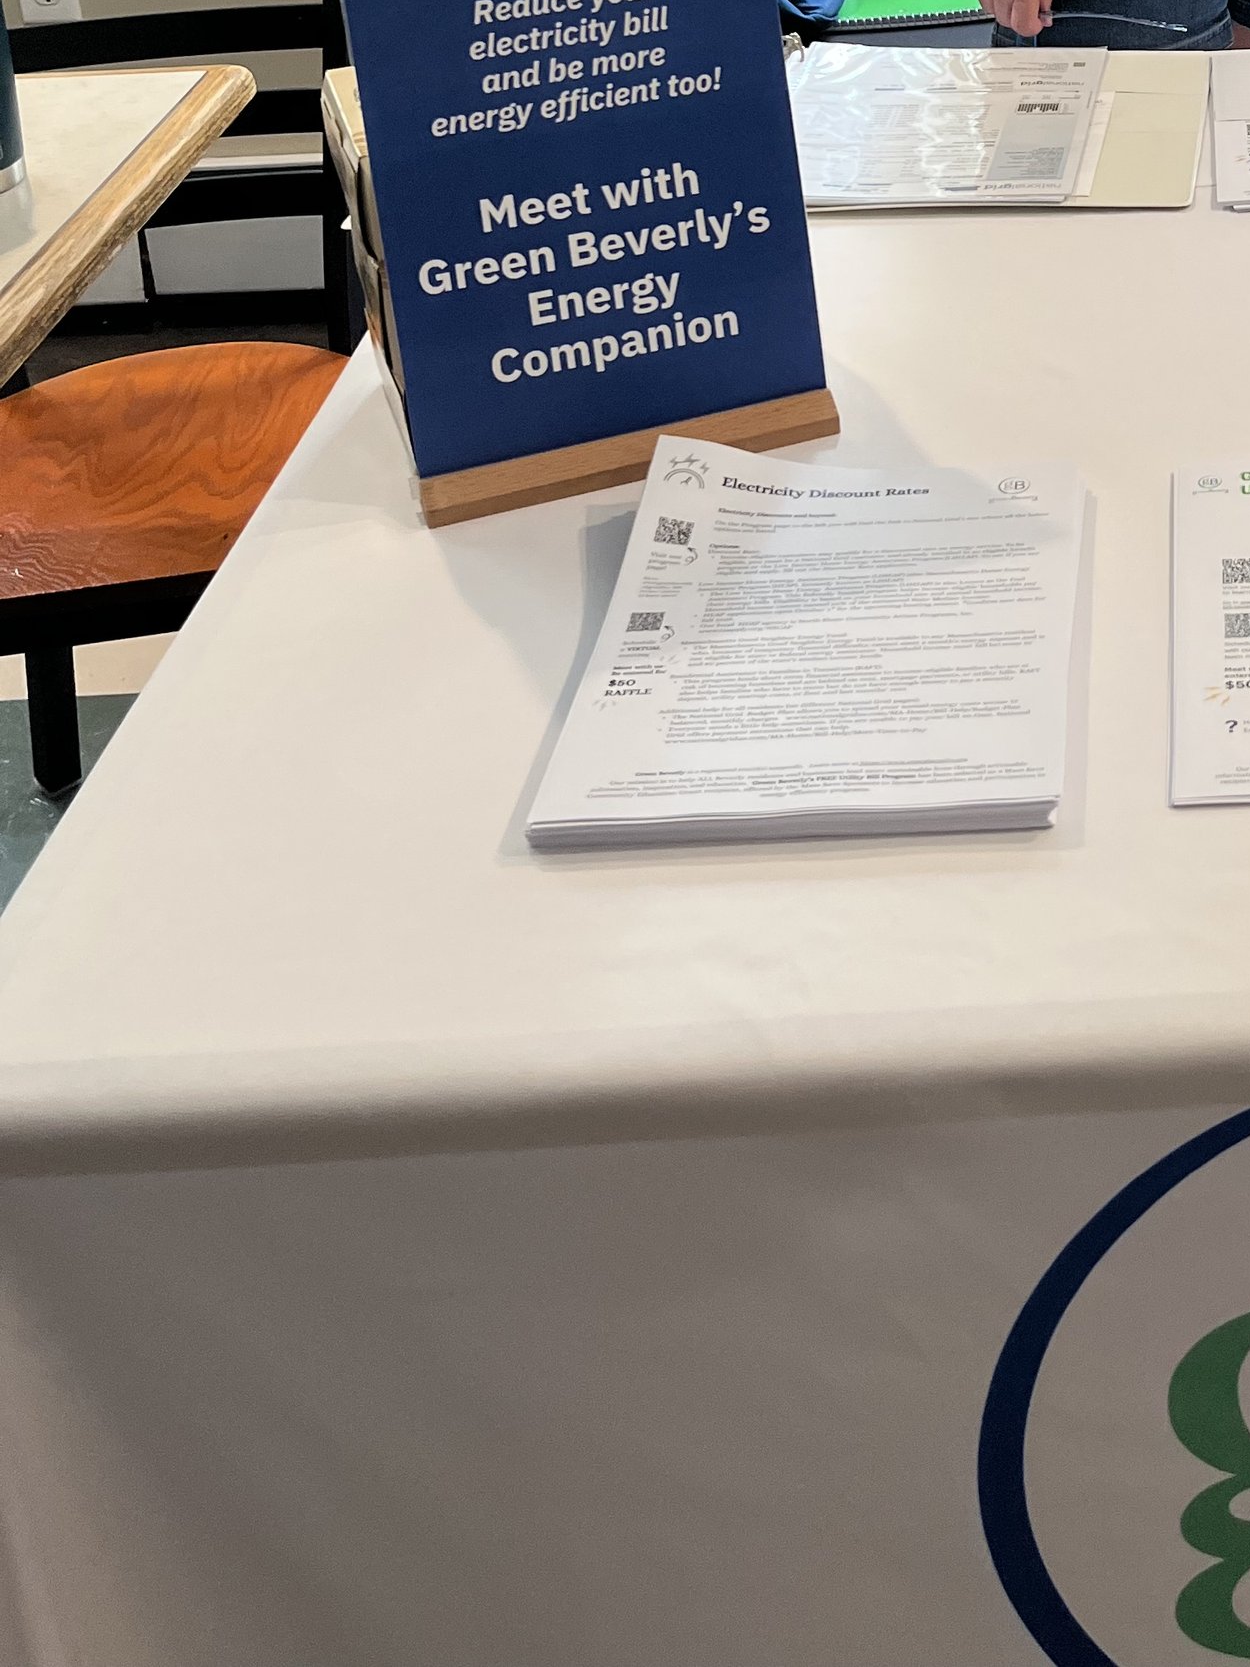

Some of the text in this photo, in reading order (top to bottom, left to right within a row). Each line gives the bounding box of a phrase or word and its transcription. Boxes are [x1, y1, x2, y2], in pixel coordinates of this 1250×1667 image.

[468, 6, 669, 62] electricity bill
[481, 45, 667, 95] and be more
[430, 66, 723, 138] energy efficient too!
[479, 162, 700, 233] Meet with
[418, 200, 772, 296] Green Beverly's
[527, 270, 681, 327] Energy
[491, 310, 740, 384] Companion
[721, 476, 930, 499] Electricity Discount Rates
[604, 688, 653, 696] RAFFLE
[1225, 719, 1239, 733] ?
